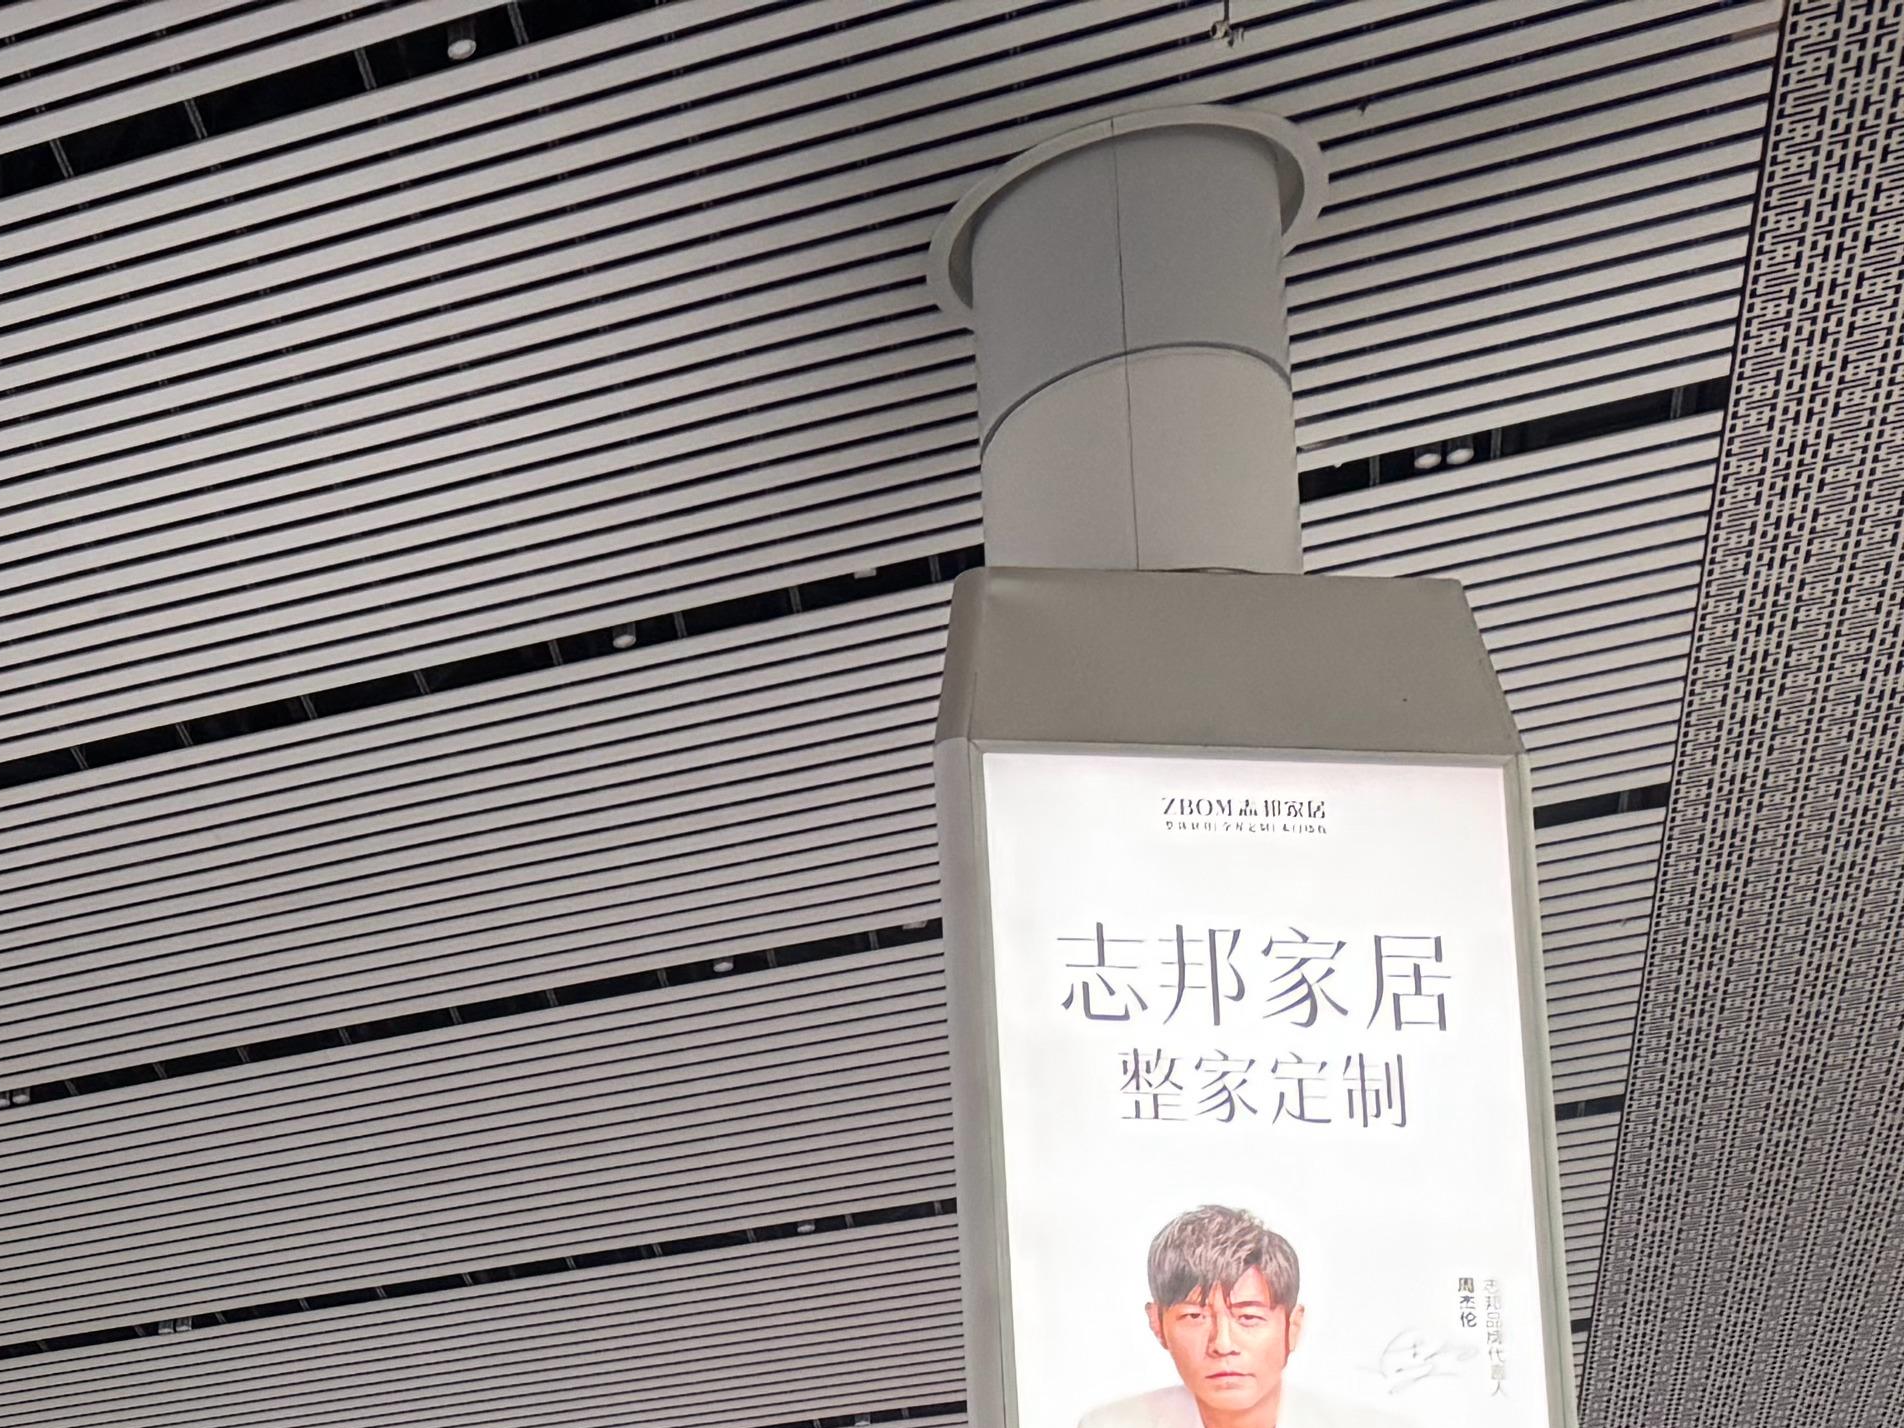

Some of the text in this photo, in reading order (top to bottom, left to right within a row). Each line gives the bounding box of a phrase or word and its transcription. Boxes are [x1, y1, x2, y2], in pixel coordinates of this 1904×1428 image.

[1161, 797, 1233, 817] ZBOM
[1056, 922, 1452, 1031] 志邦家居
[1120, 1047, 1407, 1128] 整家定制
[1458, 1277, 1477, 1328] 周杰伦
